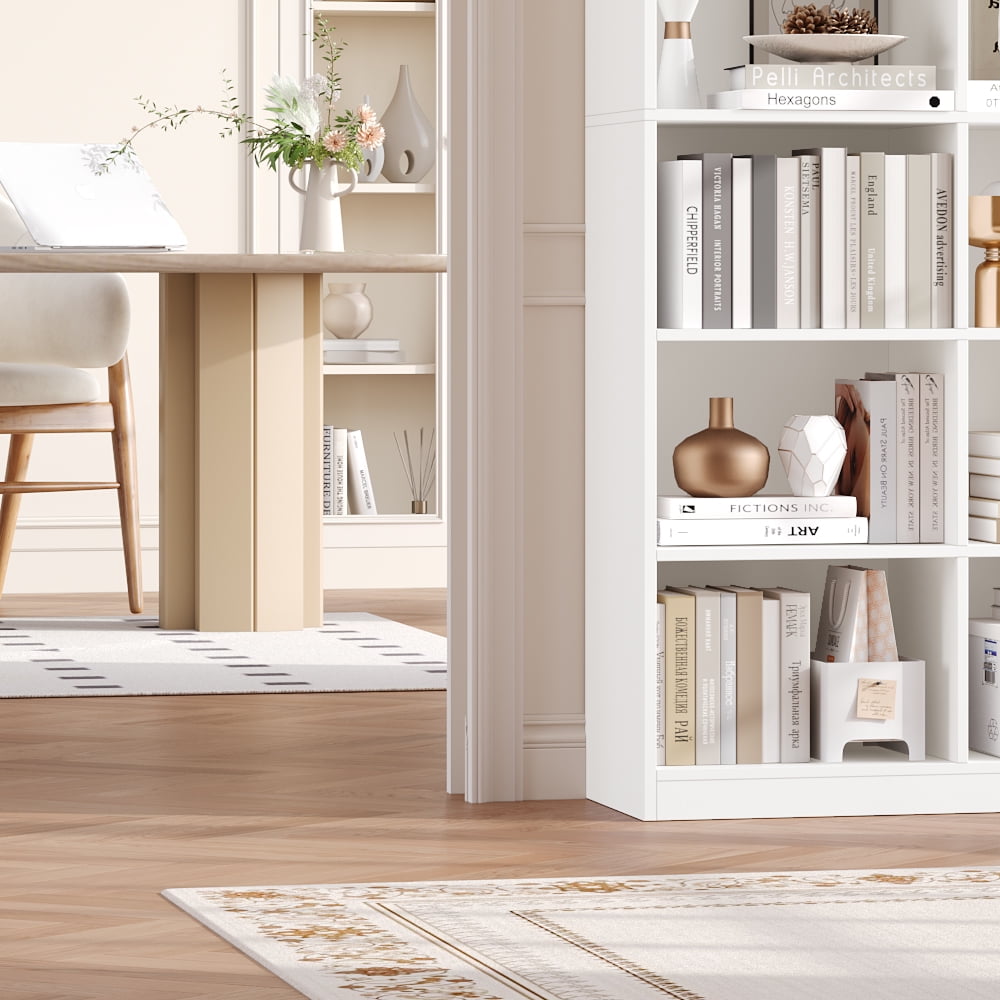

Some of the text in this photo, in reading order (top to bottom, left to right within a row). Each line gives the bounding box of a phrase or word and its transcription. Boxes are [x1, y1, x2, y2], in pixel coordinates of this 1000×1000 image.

[752, 67, 927, 88] Pelli Architects
[767, 93, 837, 108] Hexagons
[783, 185, 795, 234] KONSTEN
[802, 162, 810, 216] SIETSEMA
[865, 174, 878, 216] England
[686, 205, 698, 275] CHIPPERFIELD
[713, 167, 722, 312] VICTORIA HAGAN INTERIOR PORTRAITS
[867, 247, 876, 275] United
[934, 187, 948, 287] AVEDON advertising
[323, 428, 331, 497] FURNITURE
[730, 504, 798, 513] FICTIONS
[787, 526, 819, 536] ART
[675, 617, 688, 714] БОЖЕСТВЕННАЯ КОМЕДИЯ
[787, 660, 803, 748] Триумфальная арка
[675, 720, 692, 742] РАЙ
